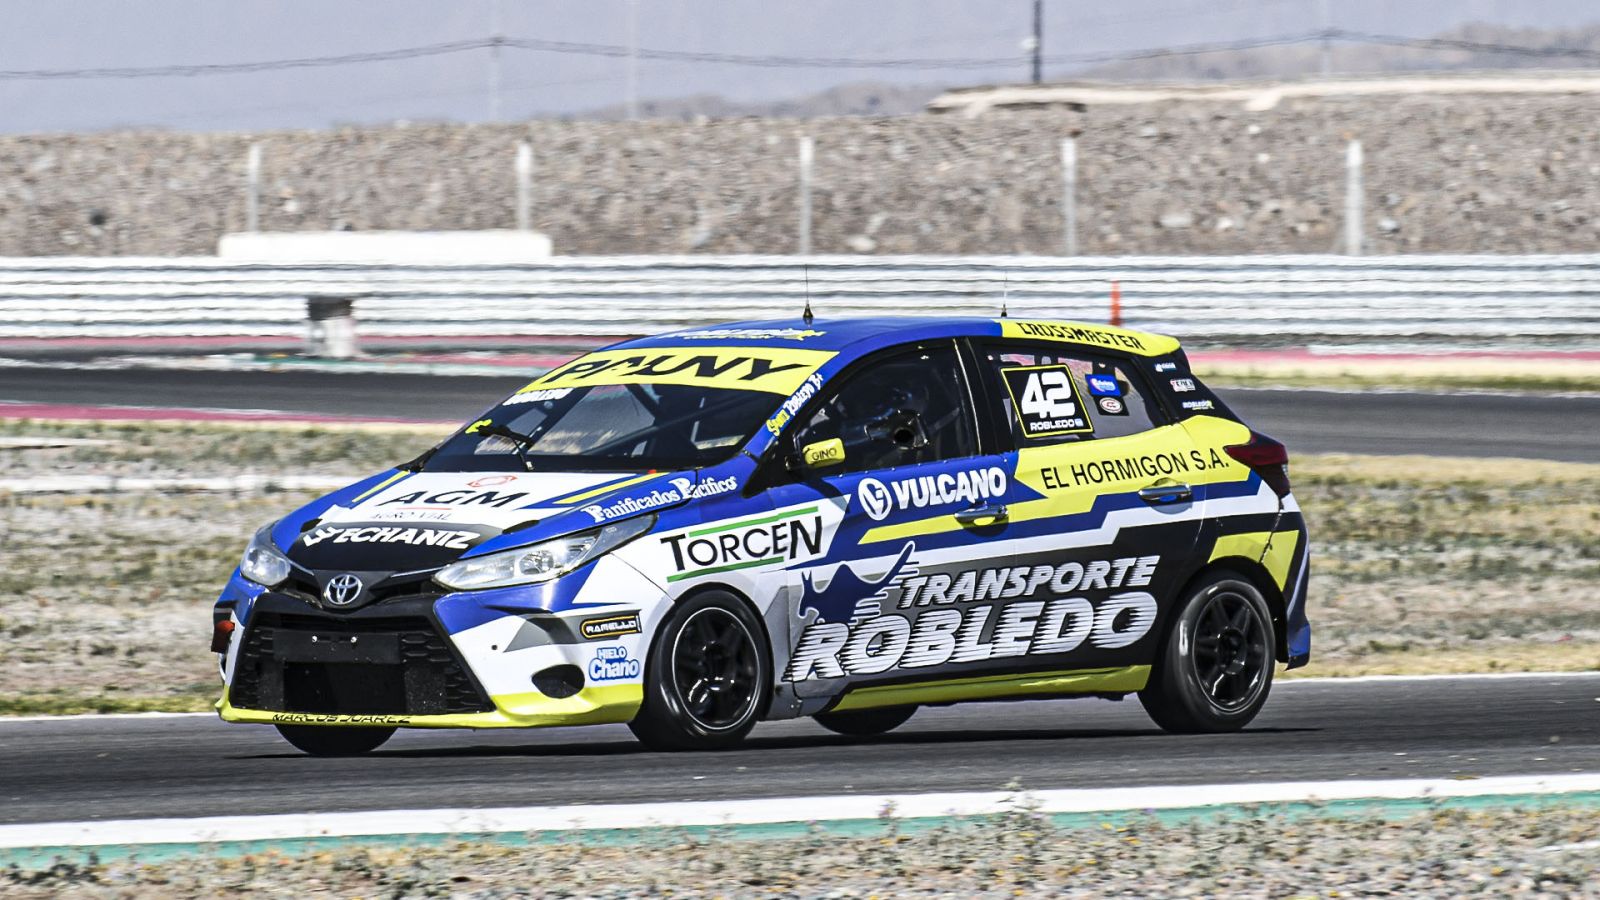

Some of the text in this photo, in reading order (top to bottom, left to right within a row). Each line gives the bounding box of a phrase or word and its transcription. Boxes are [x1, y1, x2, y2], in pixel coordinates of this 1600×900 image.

[1016, 322, 1146, 351] CROSSMASTER
[541, 354, 814, 383] PAUNY
[1021, 371, 1075, 419] 42
[1030, 419, 1075, 431] ROBLEDO
[811, 447, 837, 461] GINO
[1041, 447, 1230, 490] EL HORMIGON S.A.
[376, 490, 532, 508] AGM
[892, 466, 1007, 510] VULCANO
[581, 488, 680, 524] Panificados
[660, 516, 822, 572] TORCEN
[898, 555, 1161, 610] TRANSPORTE
[586, 620, 637, 634] RAMELLO
[781, 591, 1158, 683] ROBLEDO
[597, 647, 627, 660] HIELO
[589, 658, 640, 680] Chano
[272, 713, 410, 724] MARCOS JUAREZ
